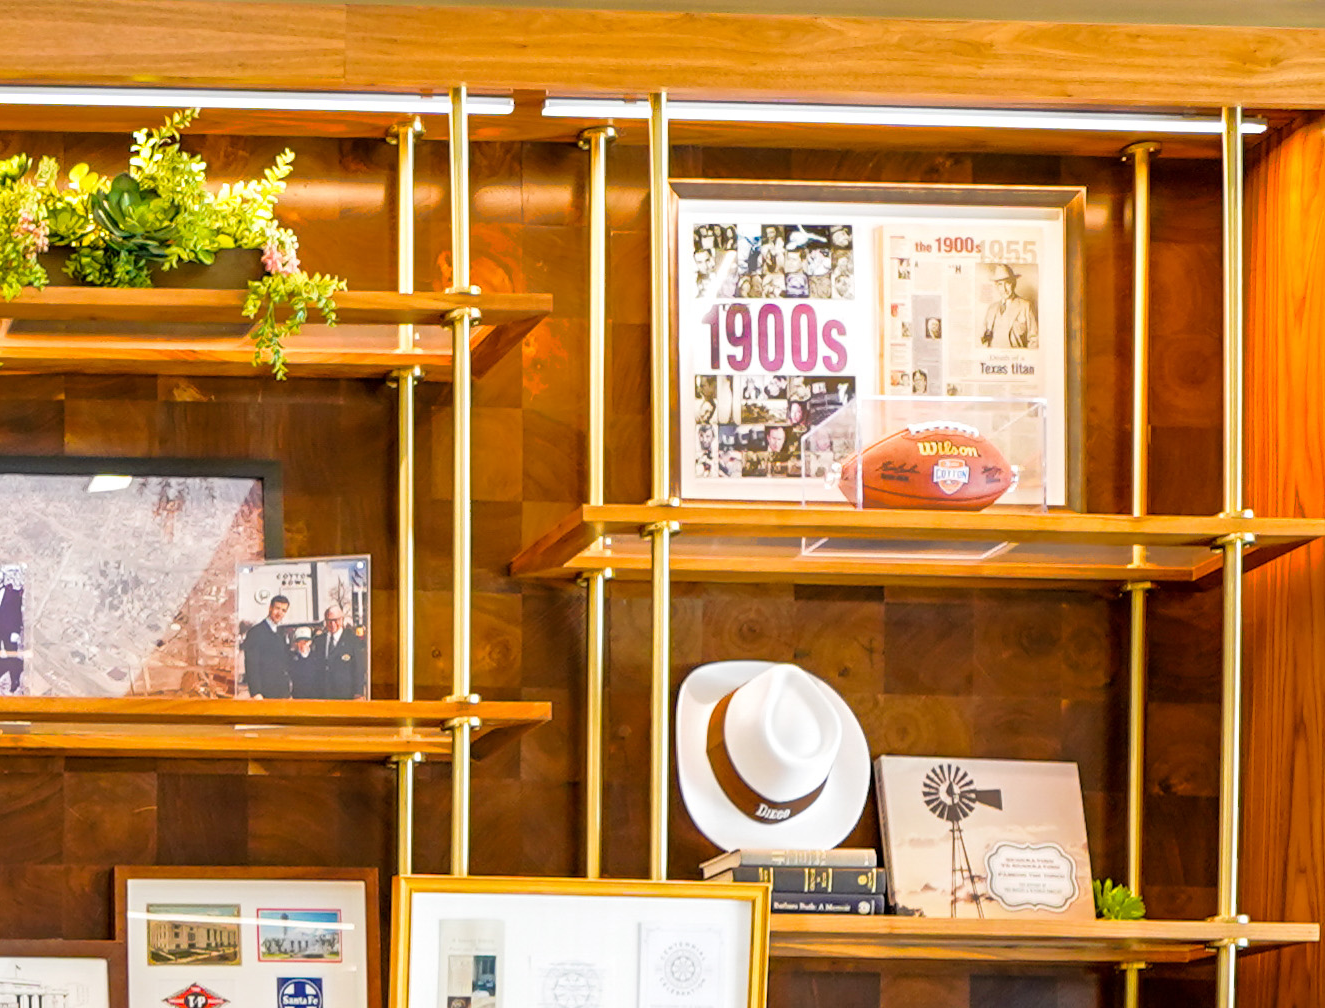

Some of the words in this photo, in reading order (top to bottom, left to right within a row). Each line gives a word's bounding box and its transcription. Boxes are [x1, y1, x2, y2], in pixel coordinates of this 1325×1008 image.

[915, 241, 932, 253] the
[935, 236, 982, 254] 1900s
[702, 303, 848, 372] 1900s
[980, 362, 1008, 374] Texas
[1011, 362, 1035, 375] titan
[917, 440, 979, 458] Wilson
[755, 803, 791, 820] DIEGO
[282, 995, 307, 1006] Santa
[307, 996, 319, 1006] Fe
